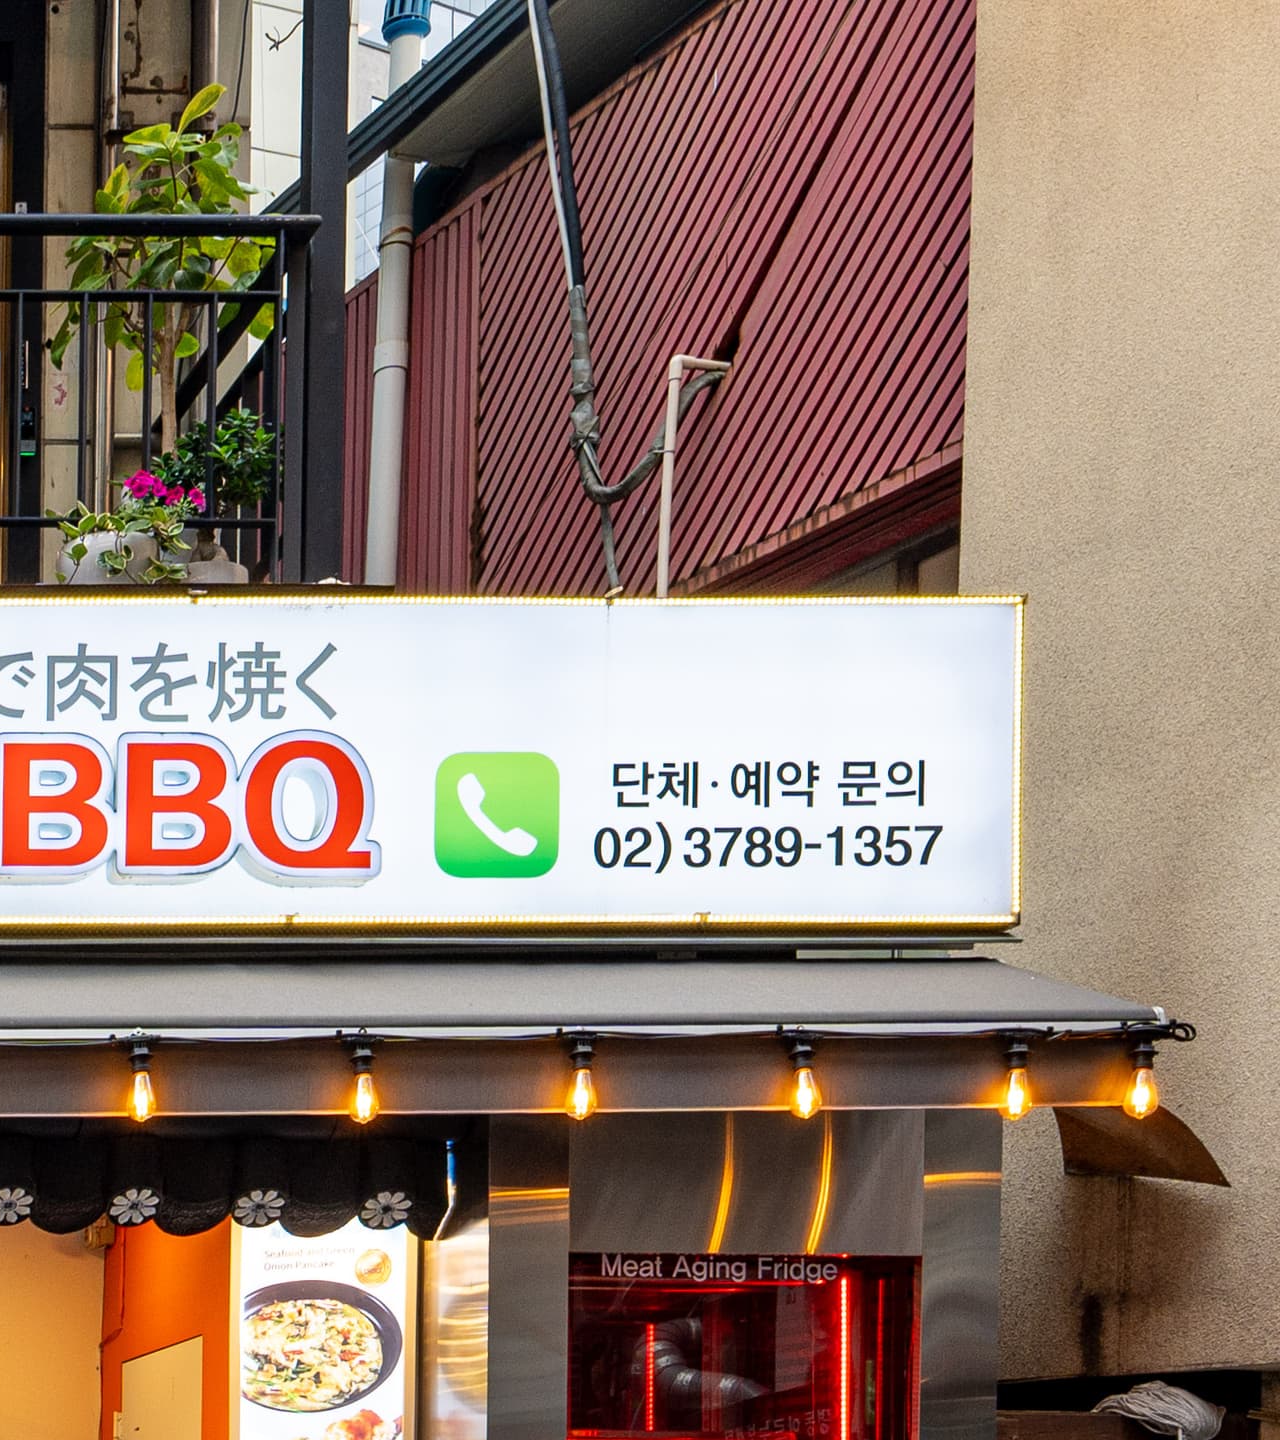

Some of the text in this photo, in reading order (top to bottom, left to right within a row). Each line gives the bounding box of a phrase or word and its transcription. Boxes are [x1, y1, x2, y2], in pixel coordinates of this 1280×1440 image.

[837, 759, 927, 806] 문의
[600, 1254, 839, 1283] Meat Aging Fridge
